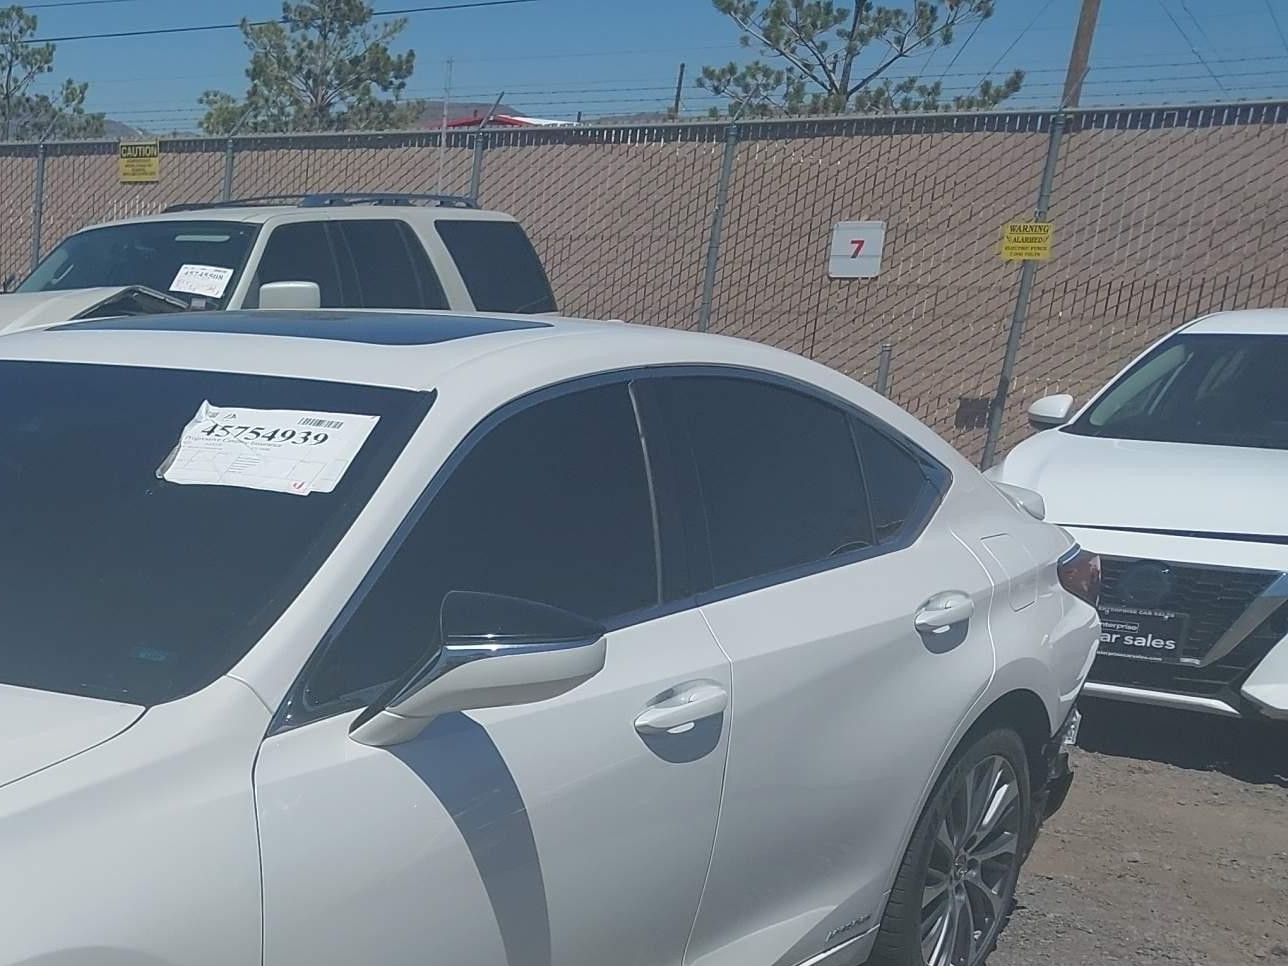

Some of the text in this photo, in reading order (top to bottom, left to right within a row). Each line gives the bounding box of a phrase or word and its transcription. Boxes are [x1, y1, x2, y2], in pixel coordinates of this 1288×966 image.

[122, 146, 157, 157] CAUTION
[1009, 224, 1049, 233] WARNING
[850, 239, 865, 259] 7
[201, 423, 329, 446] 45754939
[1101, 621, 1138, 631] nterprise
[1100, 632, 1176, 650] ar sales
